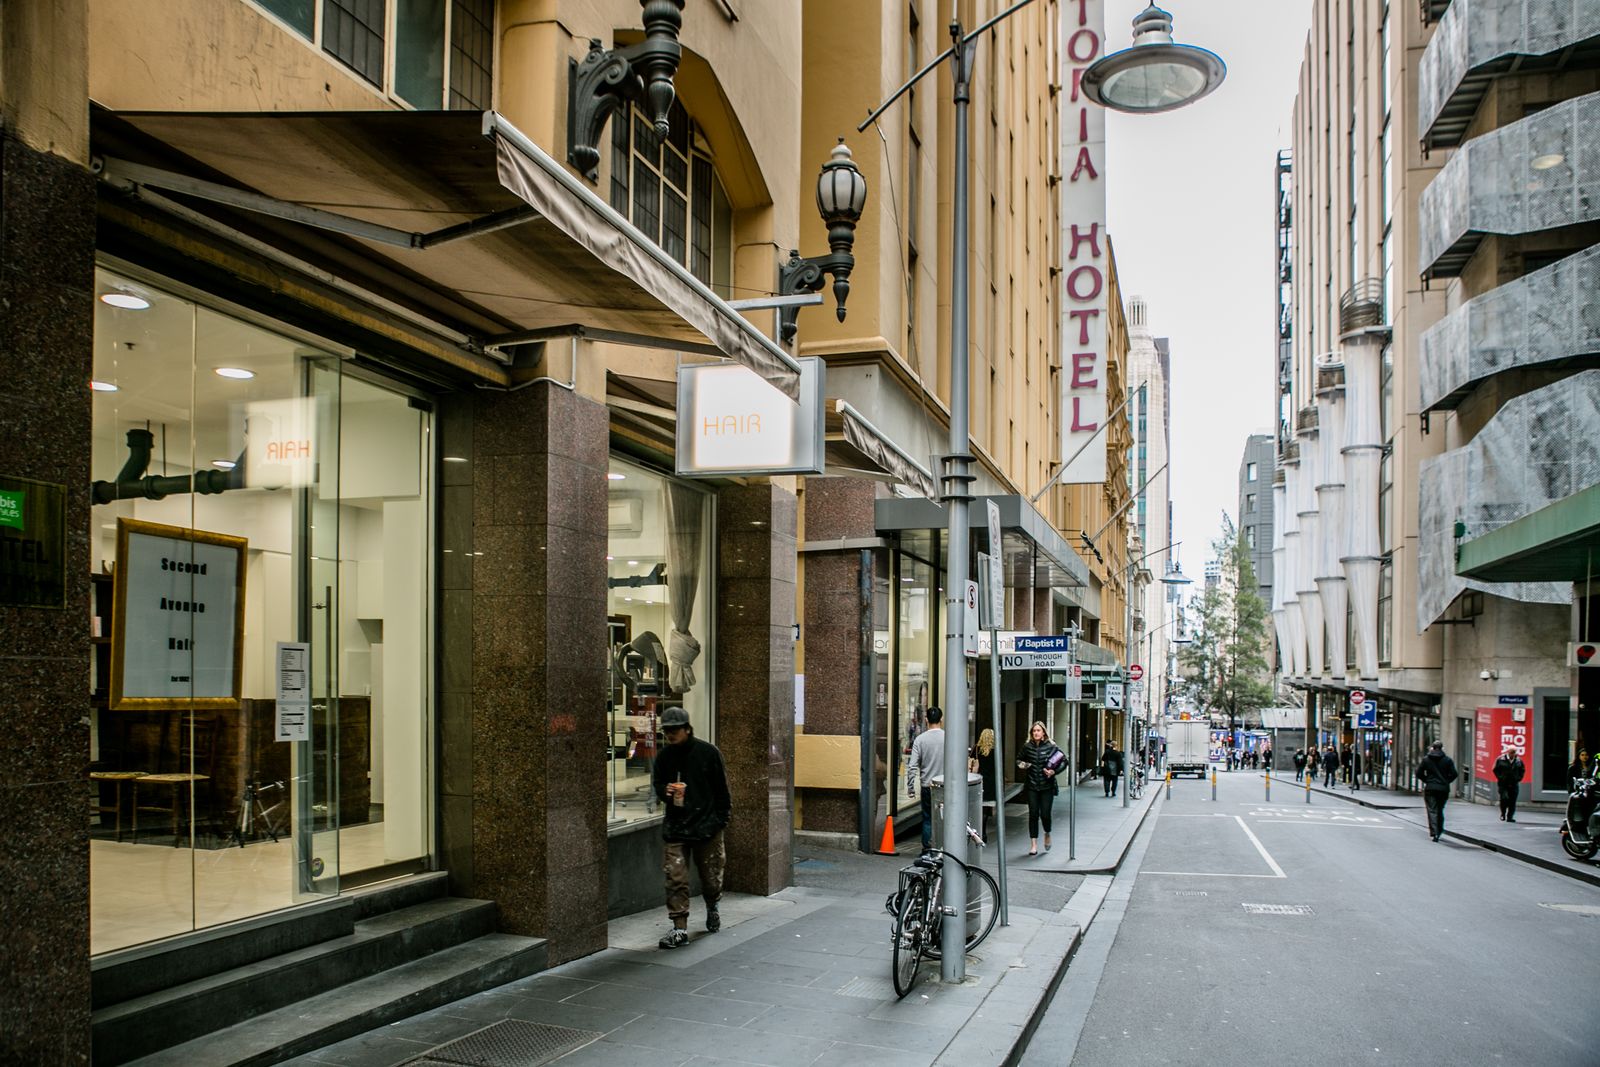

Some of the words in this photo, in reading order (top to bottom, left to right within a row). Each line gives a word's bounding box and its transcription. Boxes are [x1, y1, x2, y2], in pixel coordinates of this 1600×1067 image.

[1067, 223, 1102, 433] HOTEL
[703, 413, 761, 436] HAIR
[0, 537, 48, 565] TEL
[161, 558, 207, 575] Second
[160, 597, 205, 613] Avenue
[168, 637, 194, 651] Hair
[1025, 639, 1054, 648] Baptist
[1056, 639, 1064, 647] Pl
[1005, 656, 1023, 667] NO
[1513, 726, 1526, 757] FOR
